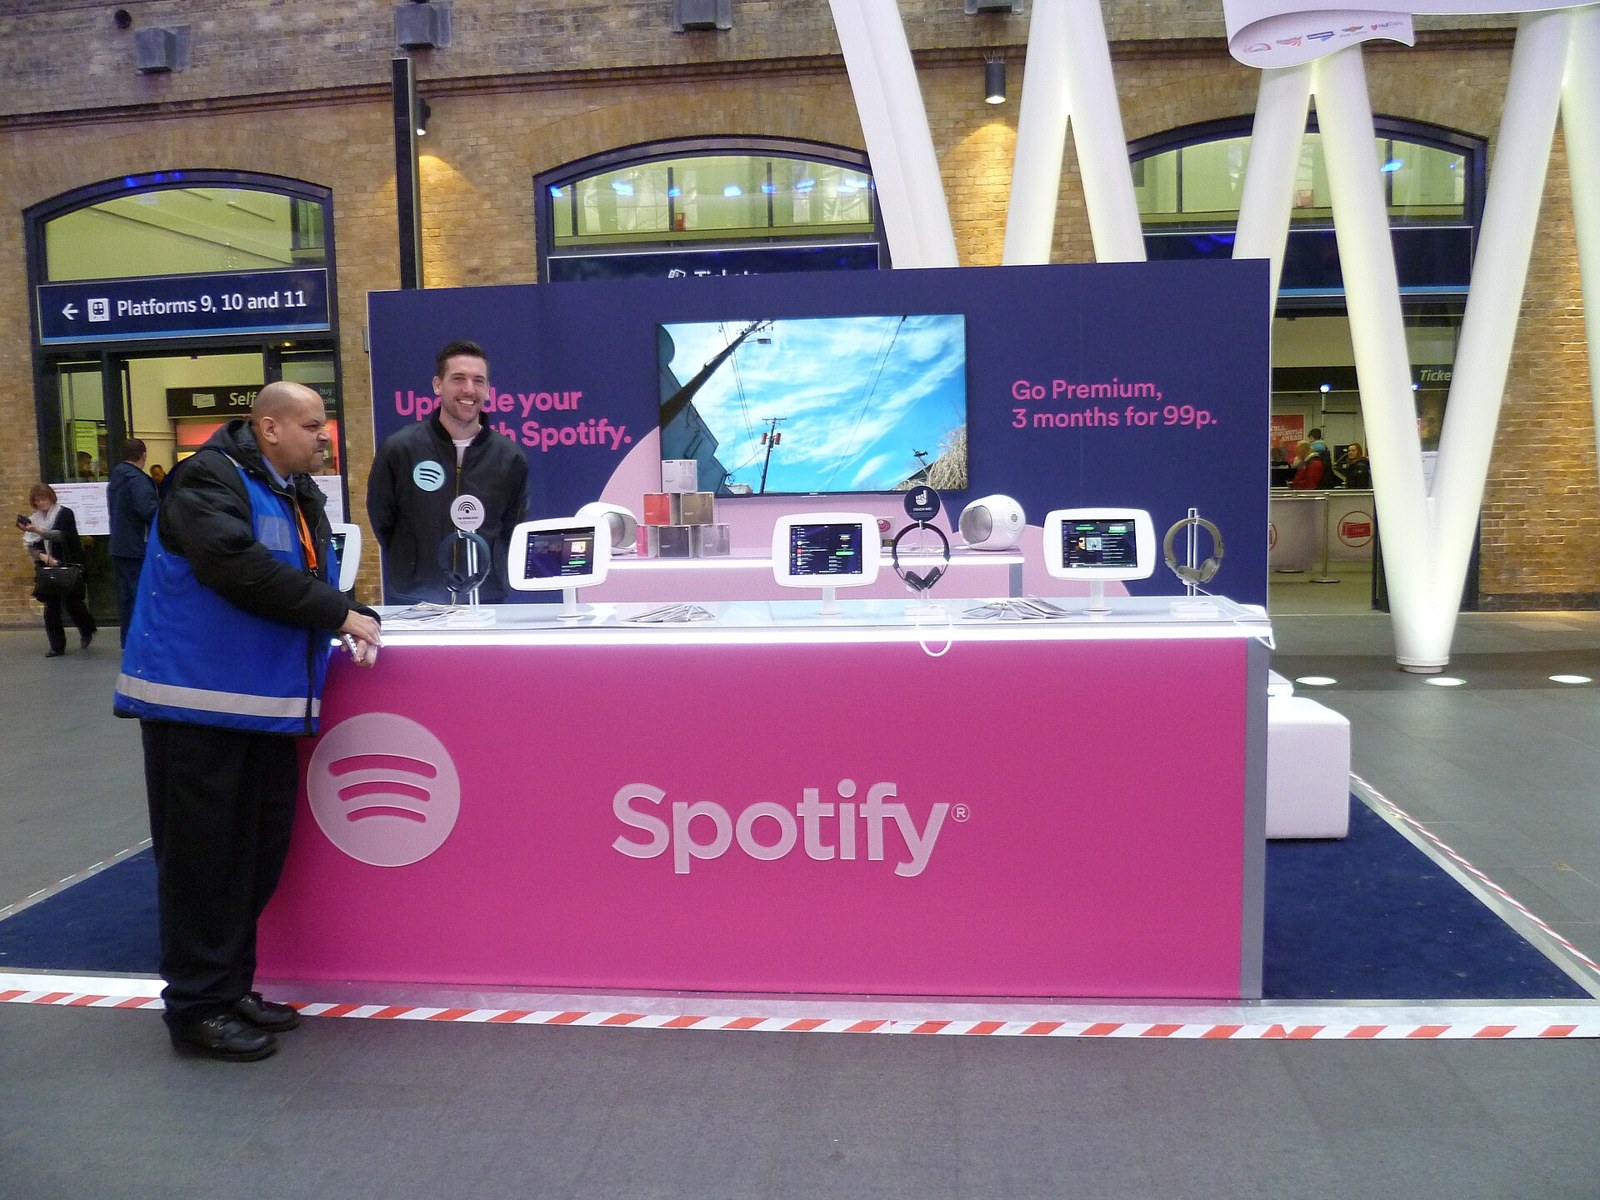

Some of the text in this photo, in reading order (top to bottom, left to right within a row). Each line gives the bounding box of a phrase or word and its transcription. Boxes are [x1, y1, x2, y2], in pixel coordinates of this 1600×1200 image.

[117, 290, 307, 317] Platforms 9, 10 and 11
[1420, 369, 1452, 382] Ticke
[1011, 377, 1163, 401] Go Premium,
[394, 387, 583, 421] Upde your
[1011, 404, 1218, 430] 3 months for 99p.
[521, 418, 632, 452] Spotify.
